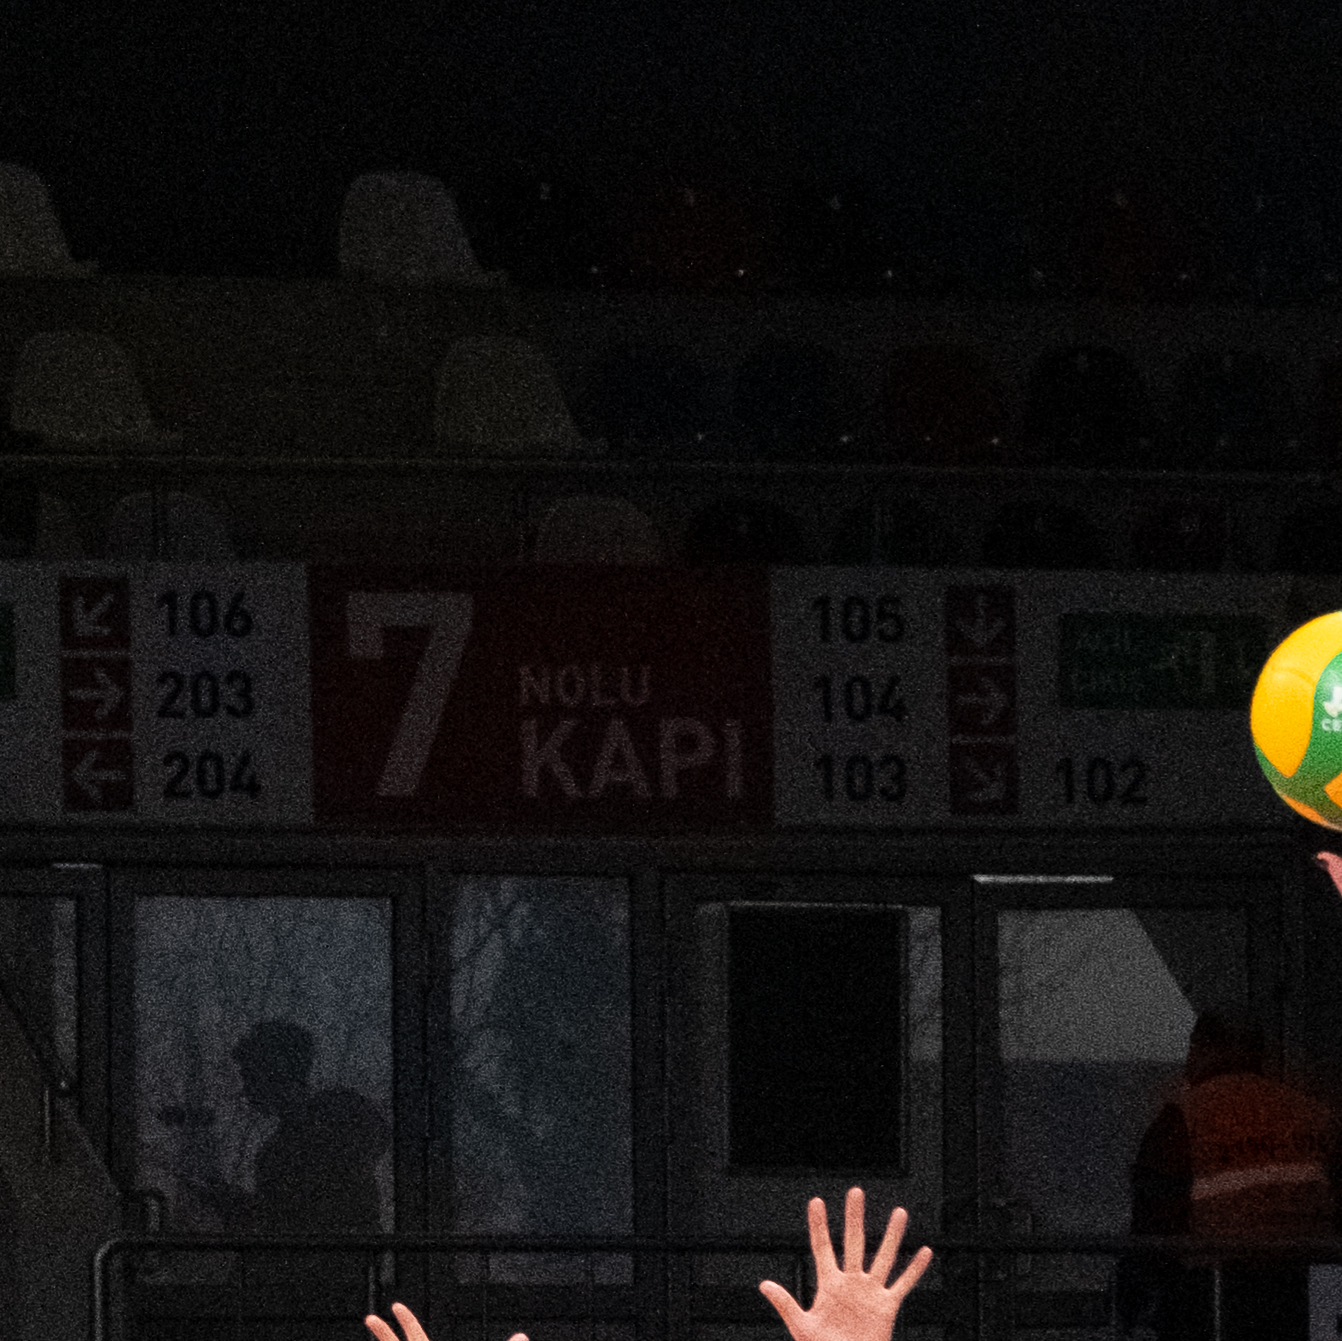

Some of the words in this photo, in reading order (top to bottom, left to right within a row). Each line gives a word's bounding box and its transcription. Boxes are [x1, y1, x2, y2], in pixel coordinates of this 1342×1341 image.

[160, 591, 254, 639] 106
[811, 598, 906, 644] 105
[155, 670, 255, 719] 203
[346, 592, 473, 797] 7
[522, 665, 651, 704] NOLU
[812, 676, 906, 723] 104
[163, 752, 262, 800] 204
[521, 716, 742, 798] KAPI
[812, 755, 908, 802] 103
[1055, 758, 1148, 804] 102
